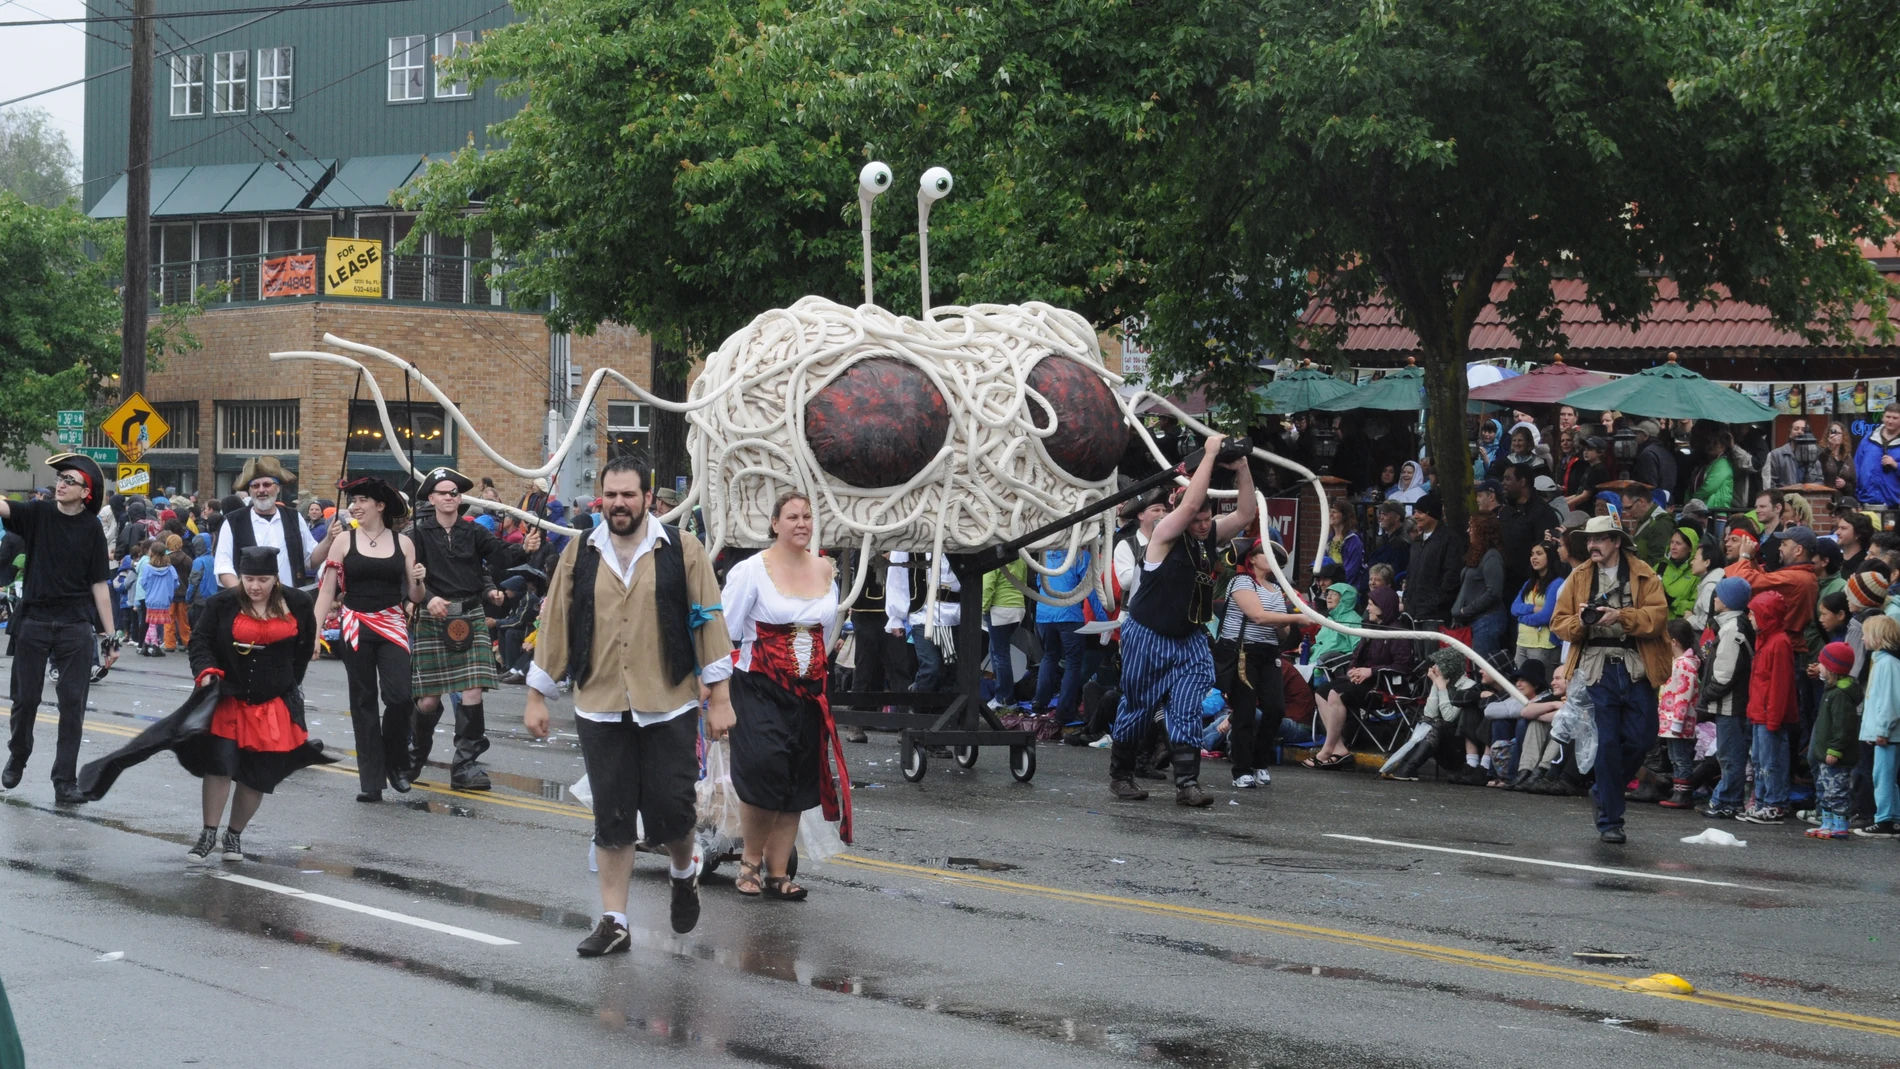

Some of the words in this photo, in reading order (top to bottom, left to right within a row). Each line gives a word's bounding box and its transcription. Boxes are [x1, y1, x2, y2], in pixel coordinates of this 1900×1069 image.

[337, 245, 355, 261] FOR
[328, 246, 379, 289] LEASE
[93, 451, 107, 460] Ave
